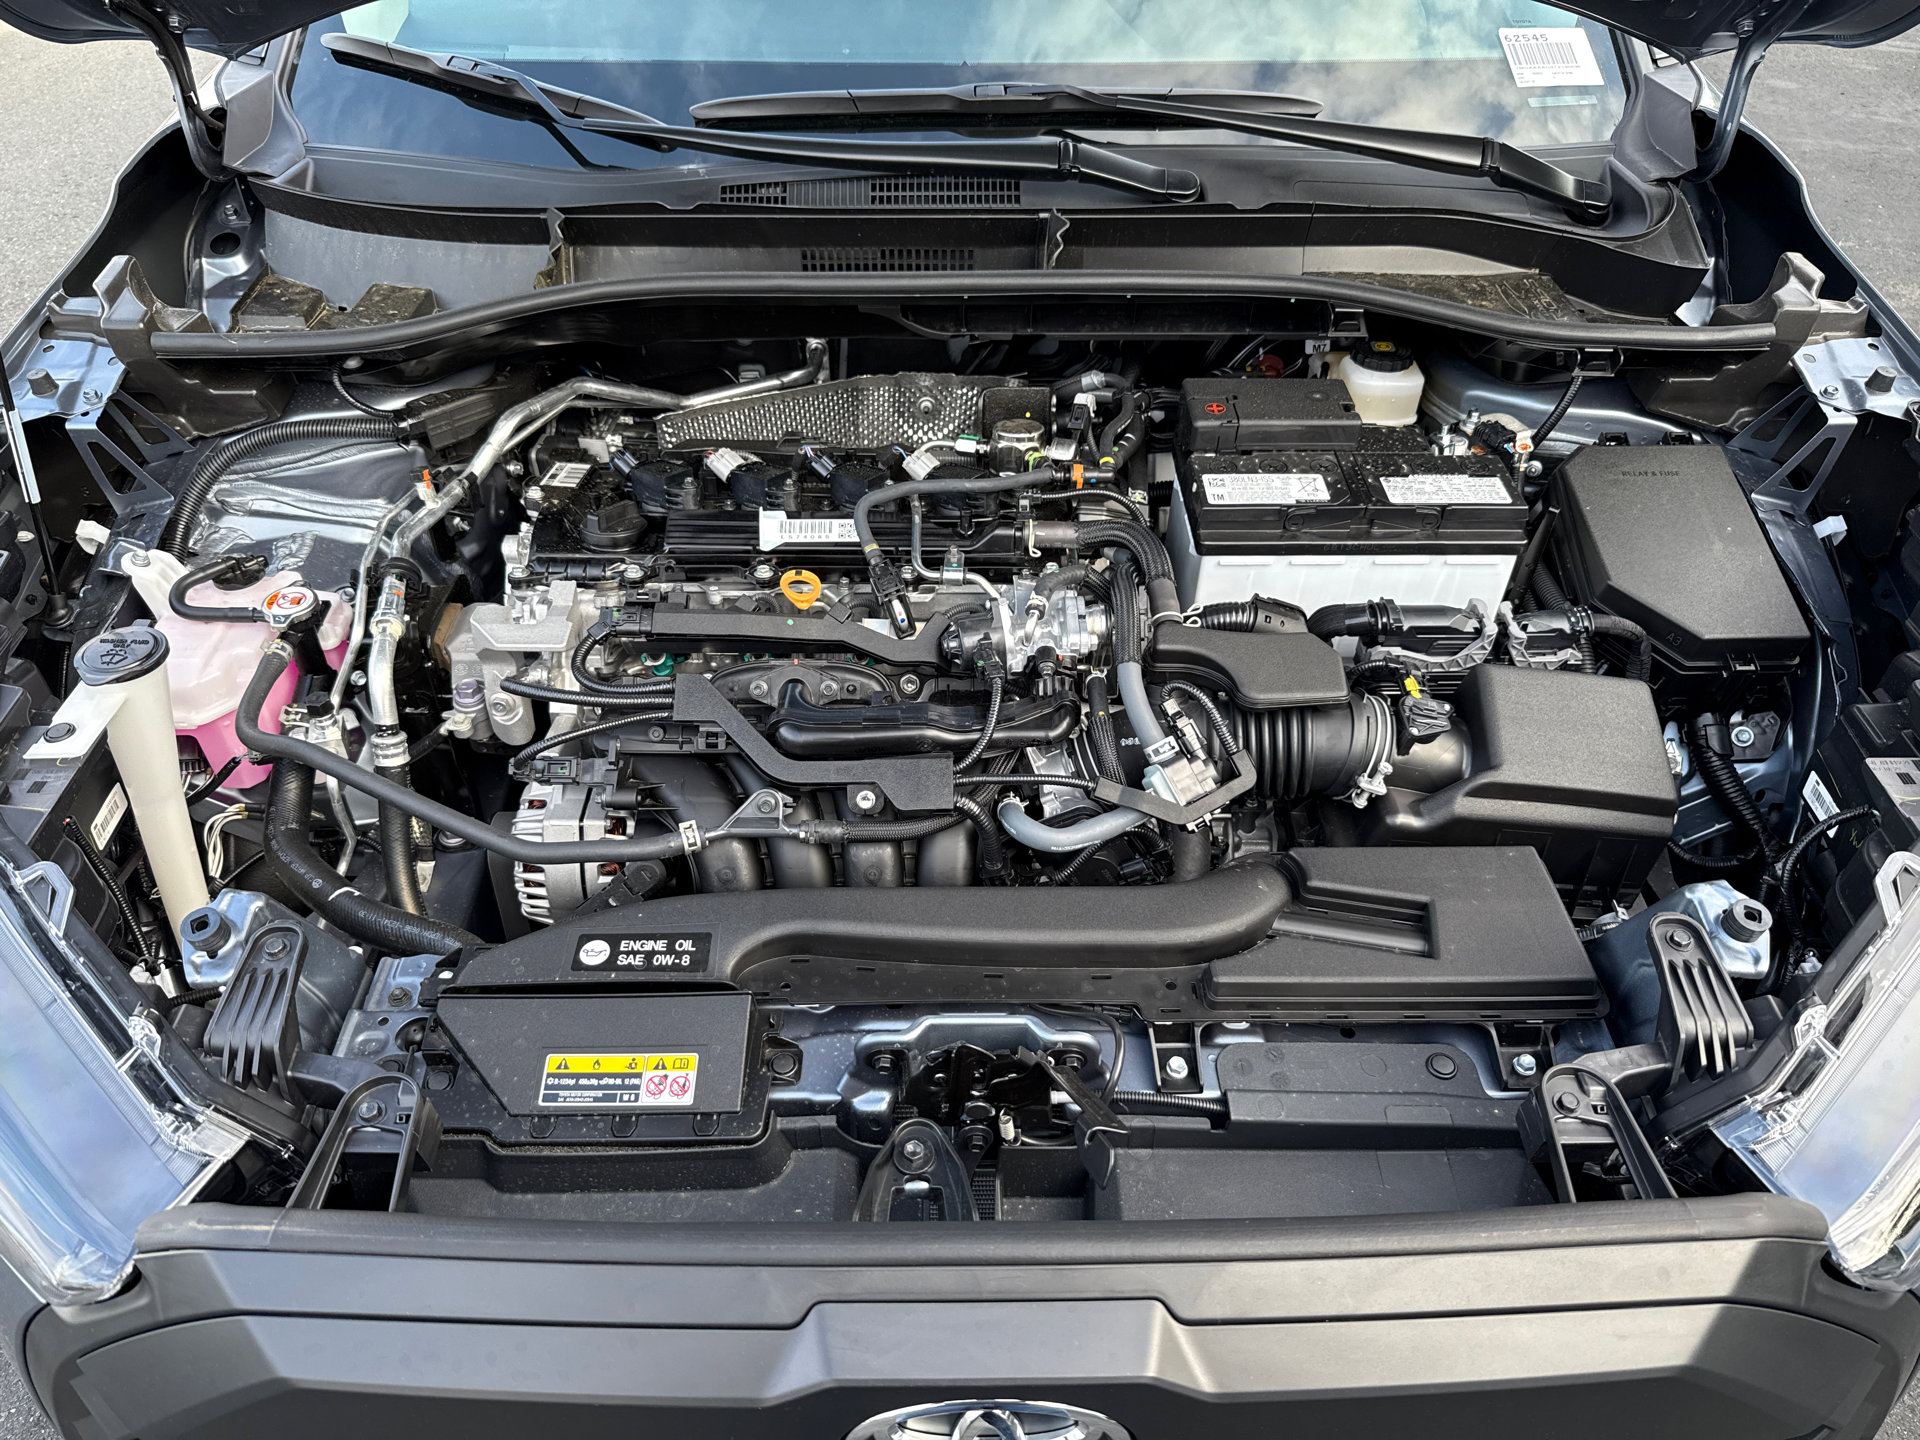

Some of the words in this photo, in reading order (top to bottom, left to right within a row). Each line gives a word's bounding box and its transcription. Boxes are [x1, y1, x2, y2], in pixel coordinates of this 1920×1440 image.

[1504, 33, 1549, 42] 62545
[1211, 493, 1225, 501] TM
[1665, 632, 1682, 646] A3
[619, 939, 668, 951] ENGINE
[674, 939, 697, 951] OIL
[616, 954, 645, 966] SAE
[652, 954, 691, 966] 0W-8
